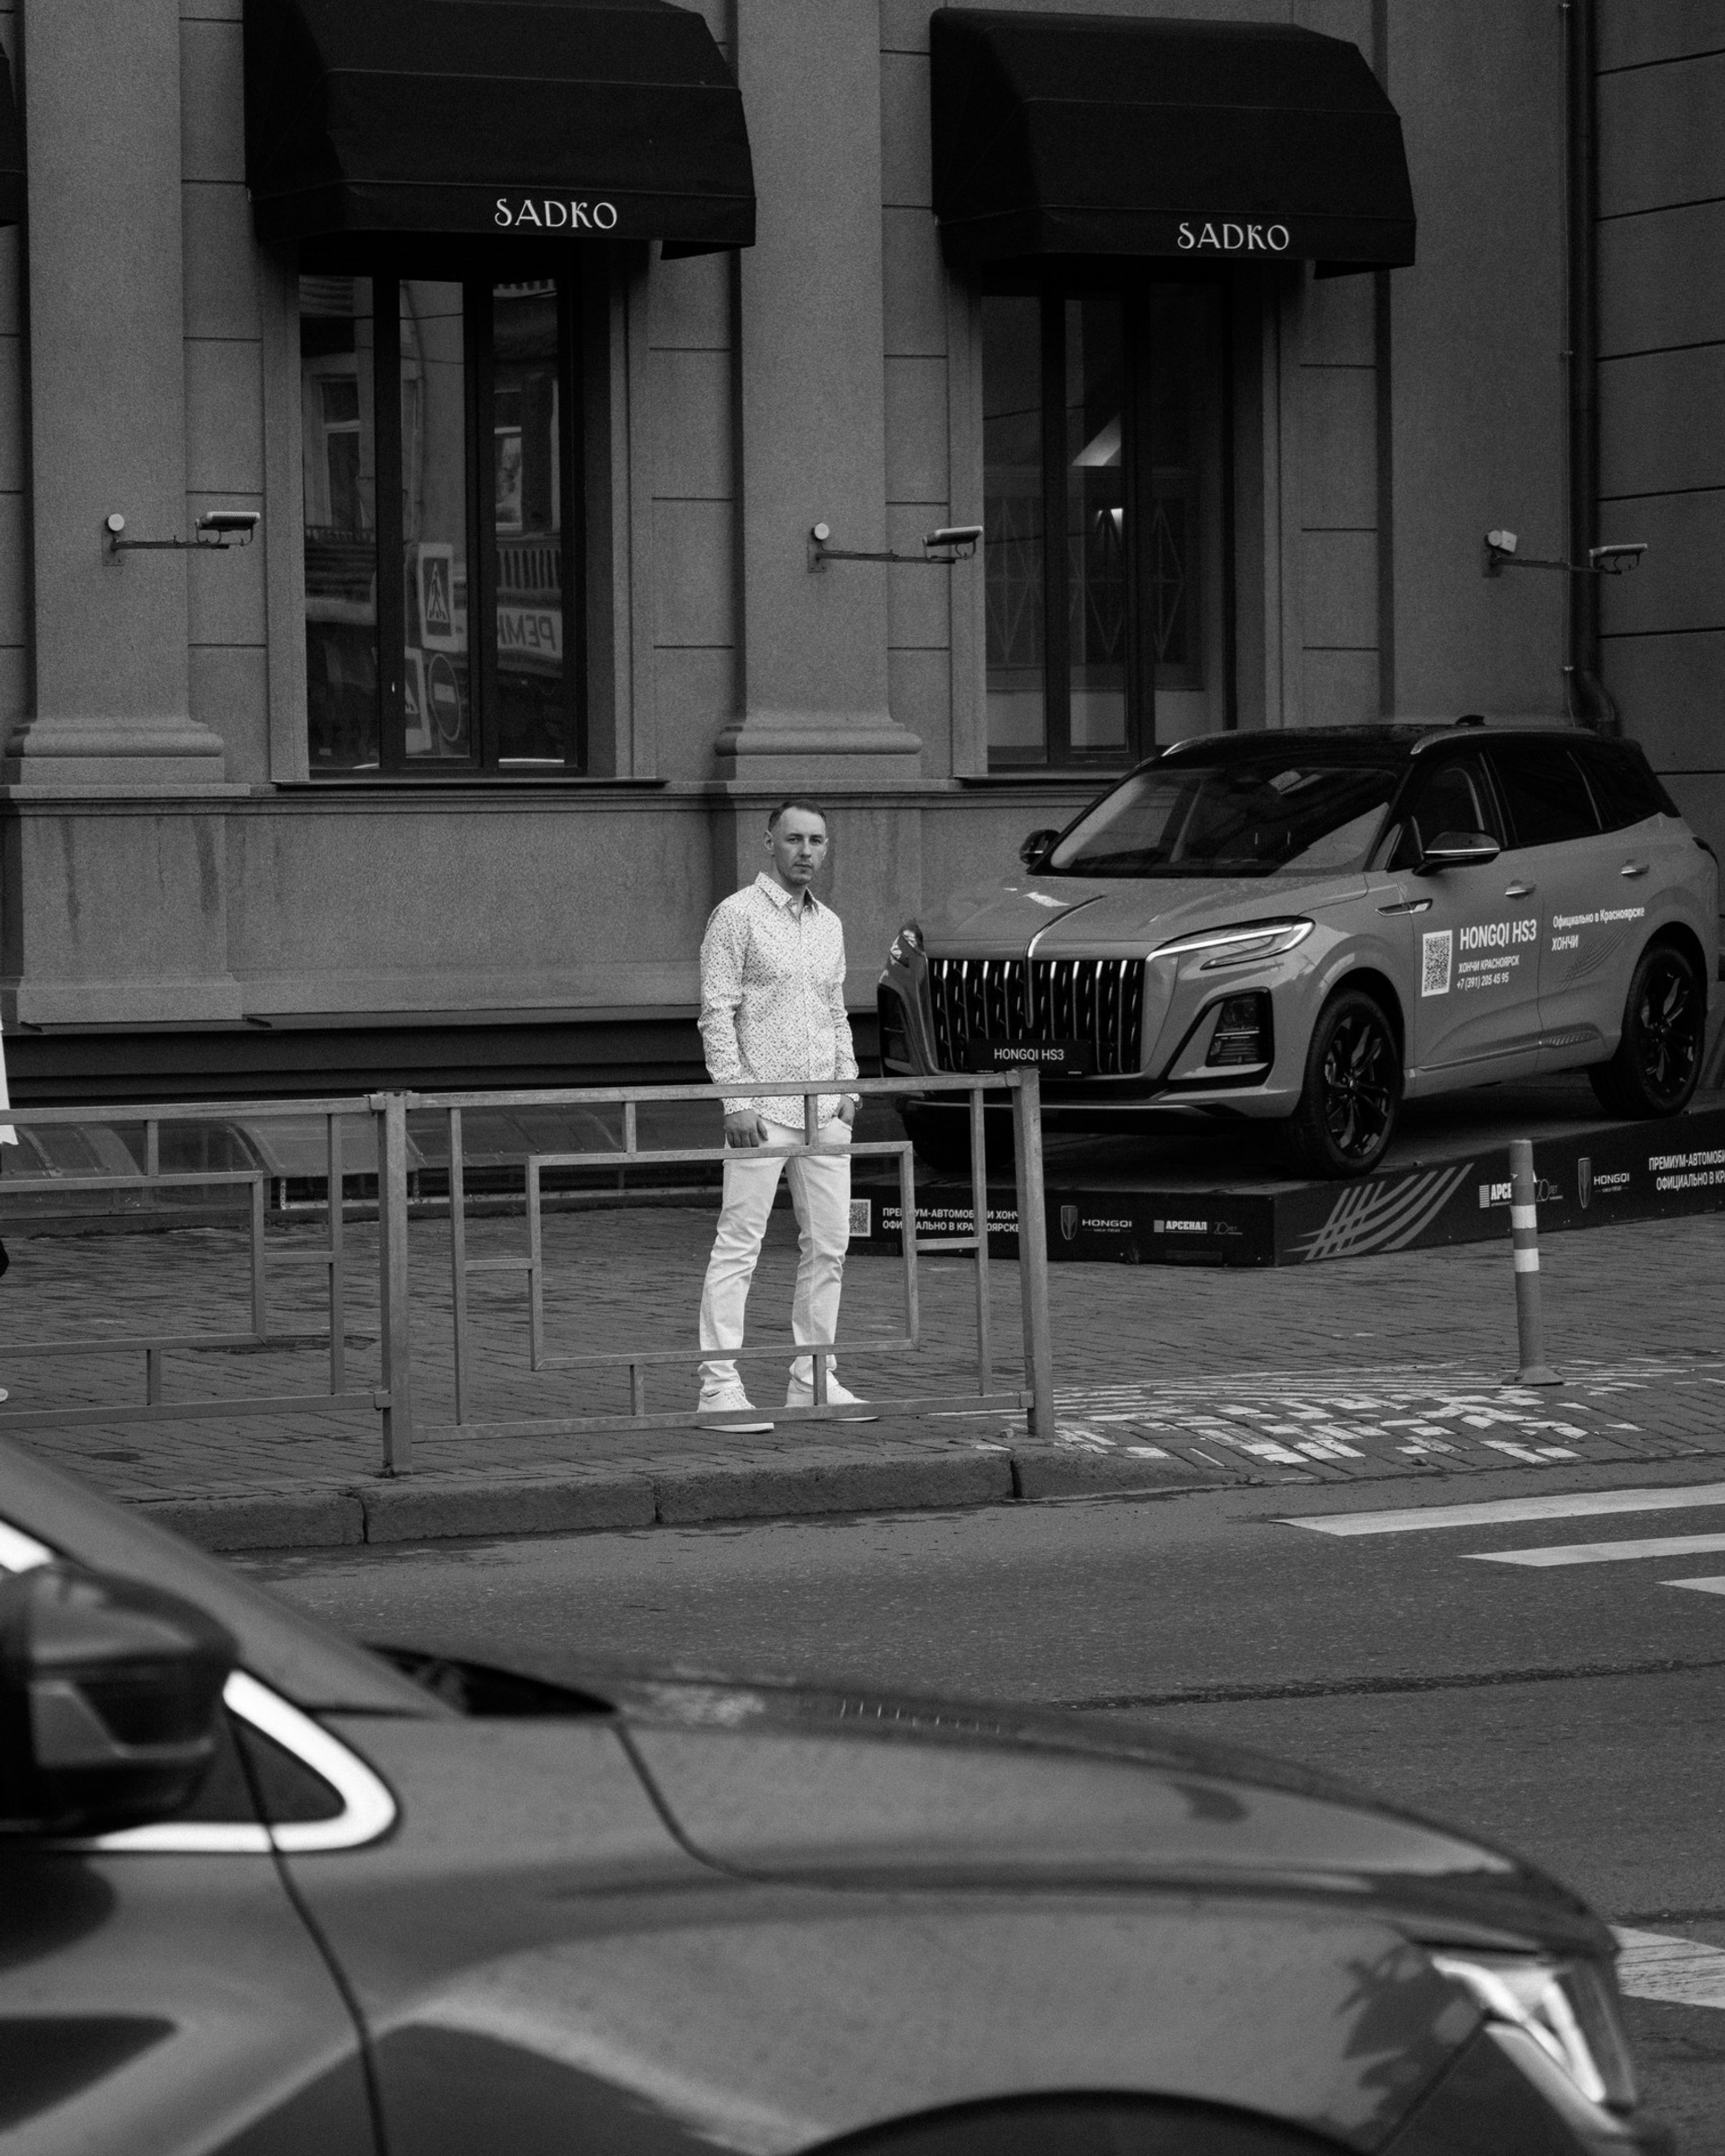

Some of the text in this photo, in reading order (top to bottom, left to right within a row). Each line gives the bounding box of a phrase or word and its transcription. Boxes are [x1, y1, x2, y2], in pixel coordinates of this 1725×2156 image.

[494, 198, 617, 230] SADKO
[1177, 222, 1290, 252] SADKO
[1552, 906, 1645, 930] Официально в Красноярске
[1459, 918, 1537, 950] HONGQI HS3
[1551, 934, 1579, 951] ХОНЧИ
[1457, 954, 1520, 974] ХОНЧИ КРАСНОЯРСК
[1456, 978, 1465, 989] +7
[1464, 976, 1481, 991] (391)
[1493, 973, 1500, 985] 45
[1501, 972, 1509, 983] 95
[994, 1048, 1065, 1061] HONGQI HS3
[1593, 1172, 1630, 1186] HONGQI
[1656, 1170, 1725, 1191] ОФИЦИАЛЬНО В КР
[1491, 1182, 1511, 1201] АРСЕ
[882, 1220, 1020, 1233] ОФИАЛЬНО В КРАОЯРСКЕ
[1082, 1219, 1133, 1228] HONGQI
[1165, 1220, 1208, 1231] АРСЕНАЛ
